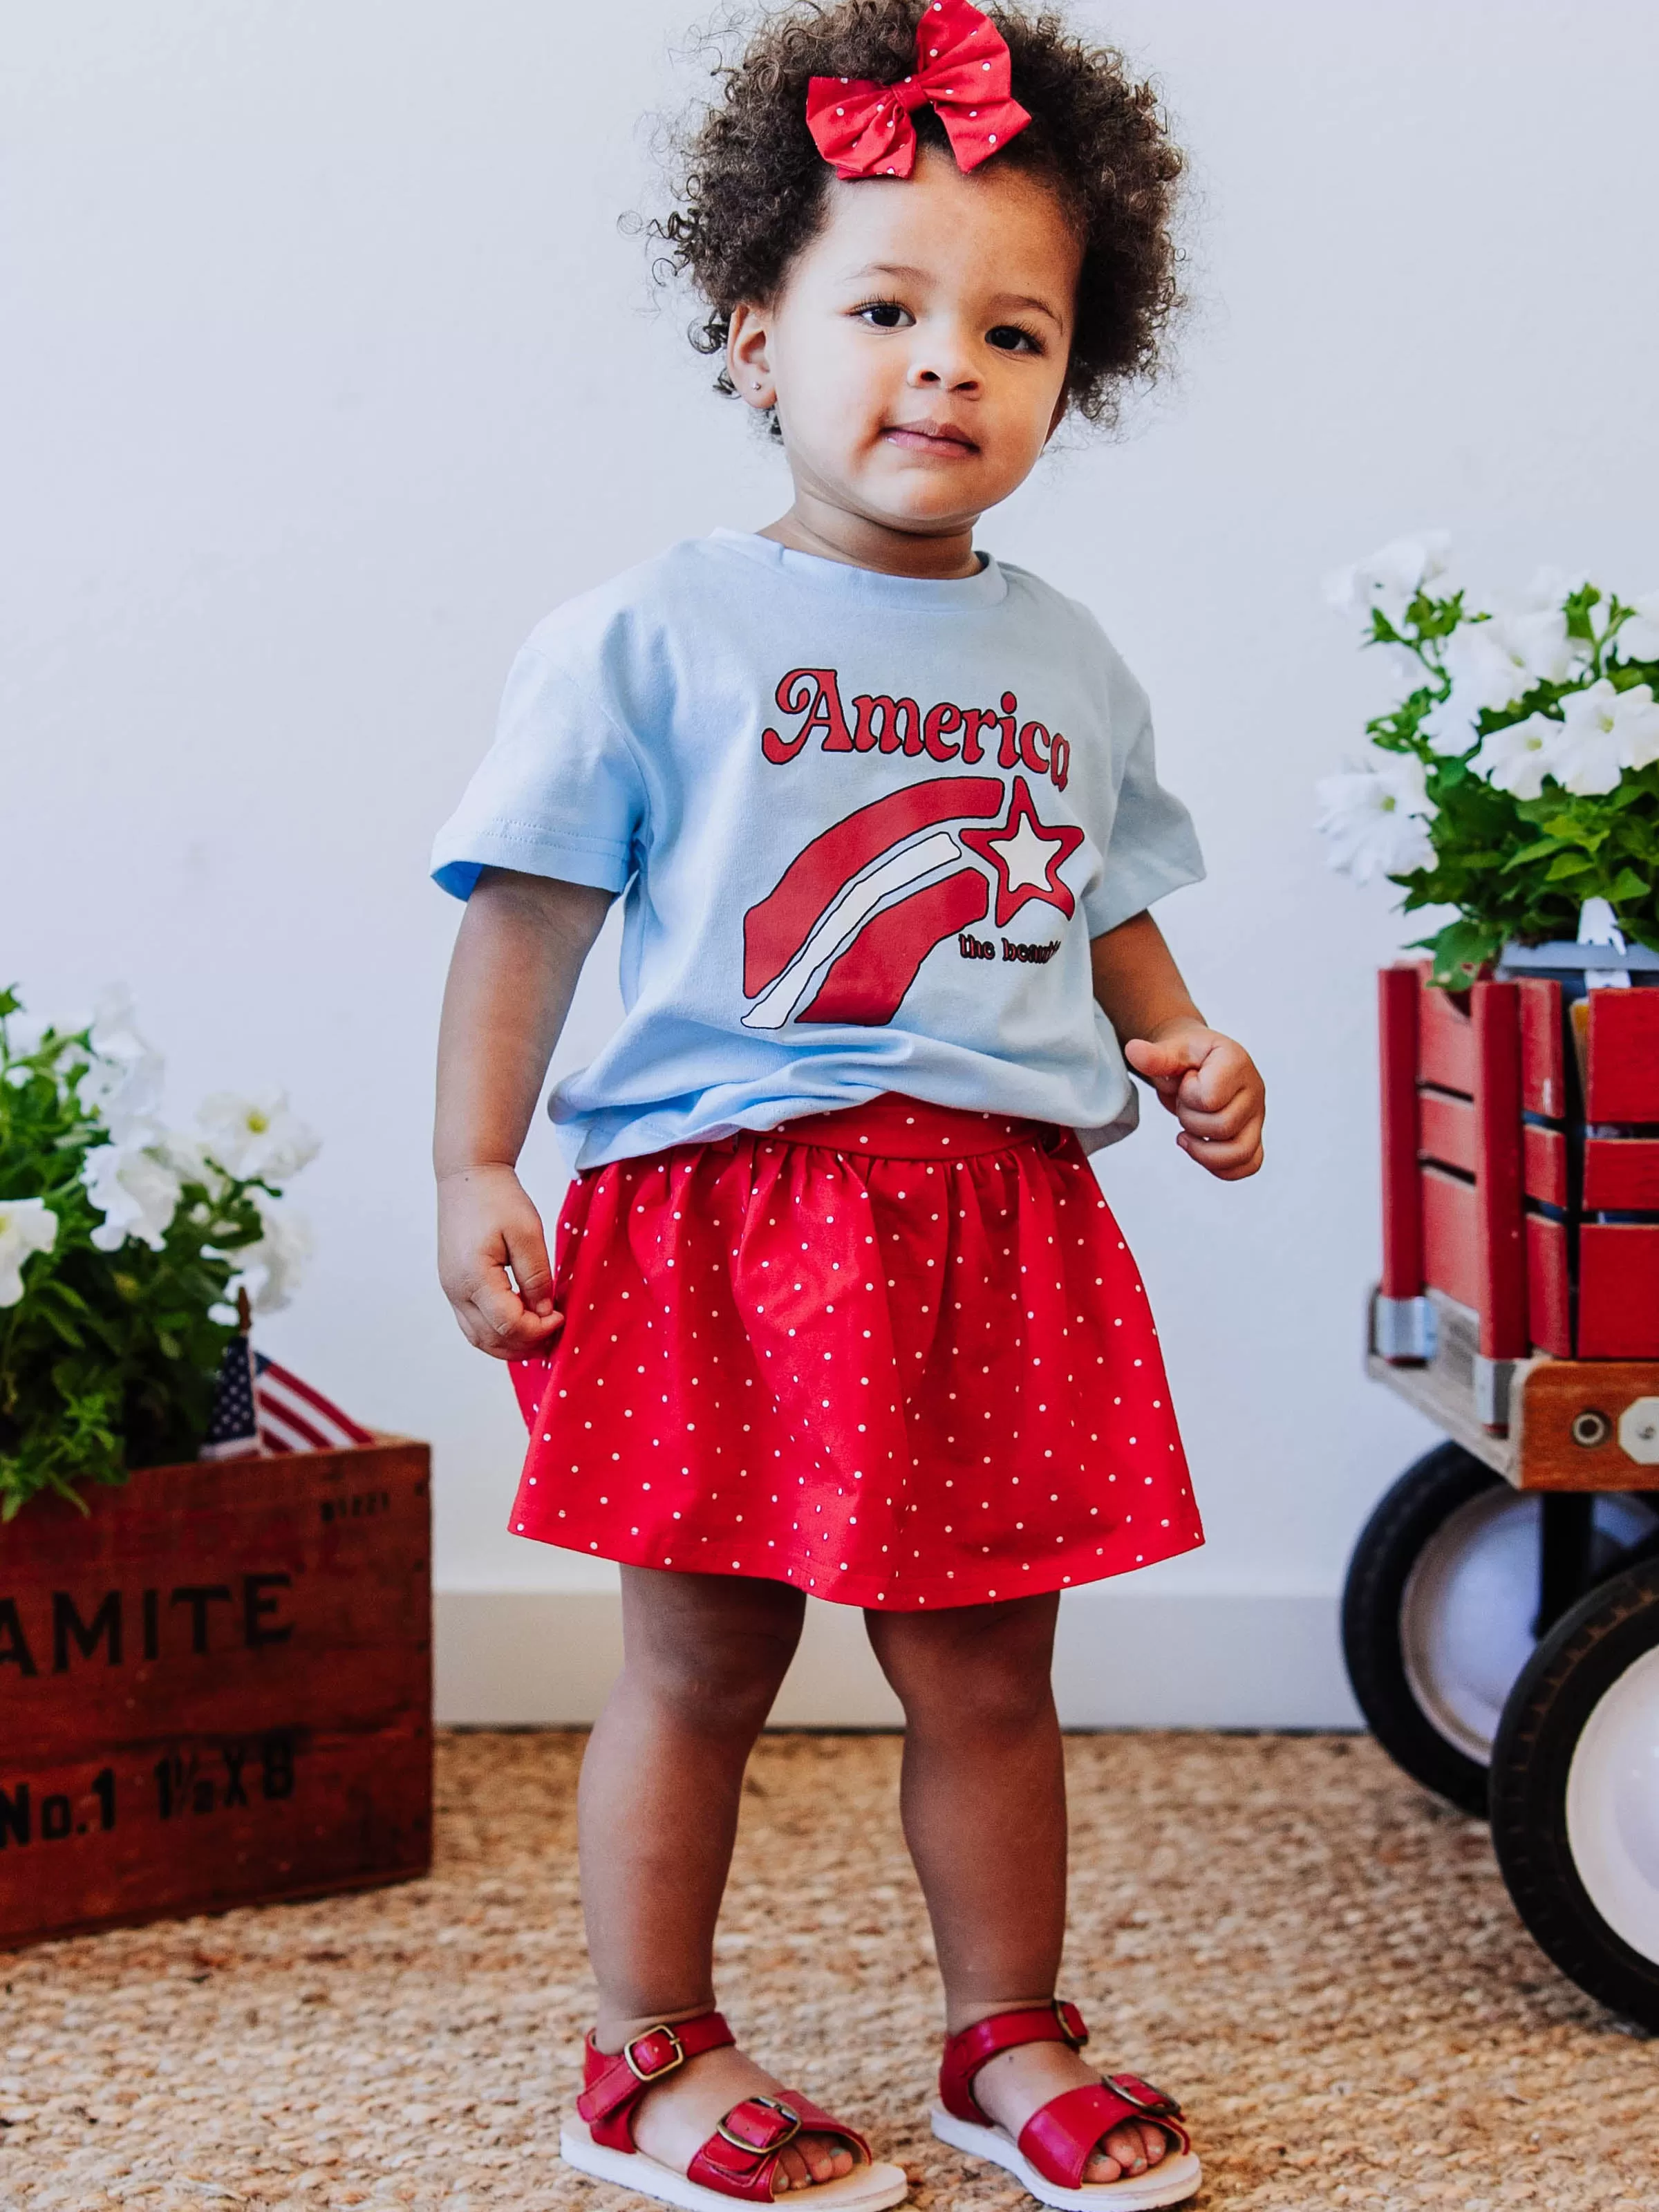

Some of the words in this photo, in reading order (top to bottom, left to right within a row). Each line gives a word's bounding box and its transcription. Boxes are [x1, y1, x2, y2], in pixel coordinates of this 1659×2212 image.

[762, 668, 1070, 791] America
[958, 933, 995, 960] the
[0, 1571, 296, 1676] AMITE
